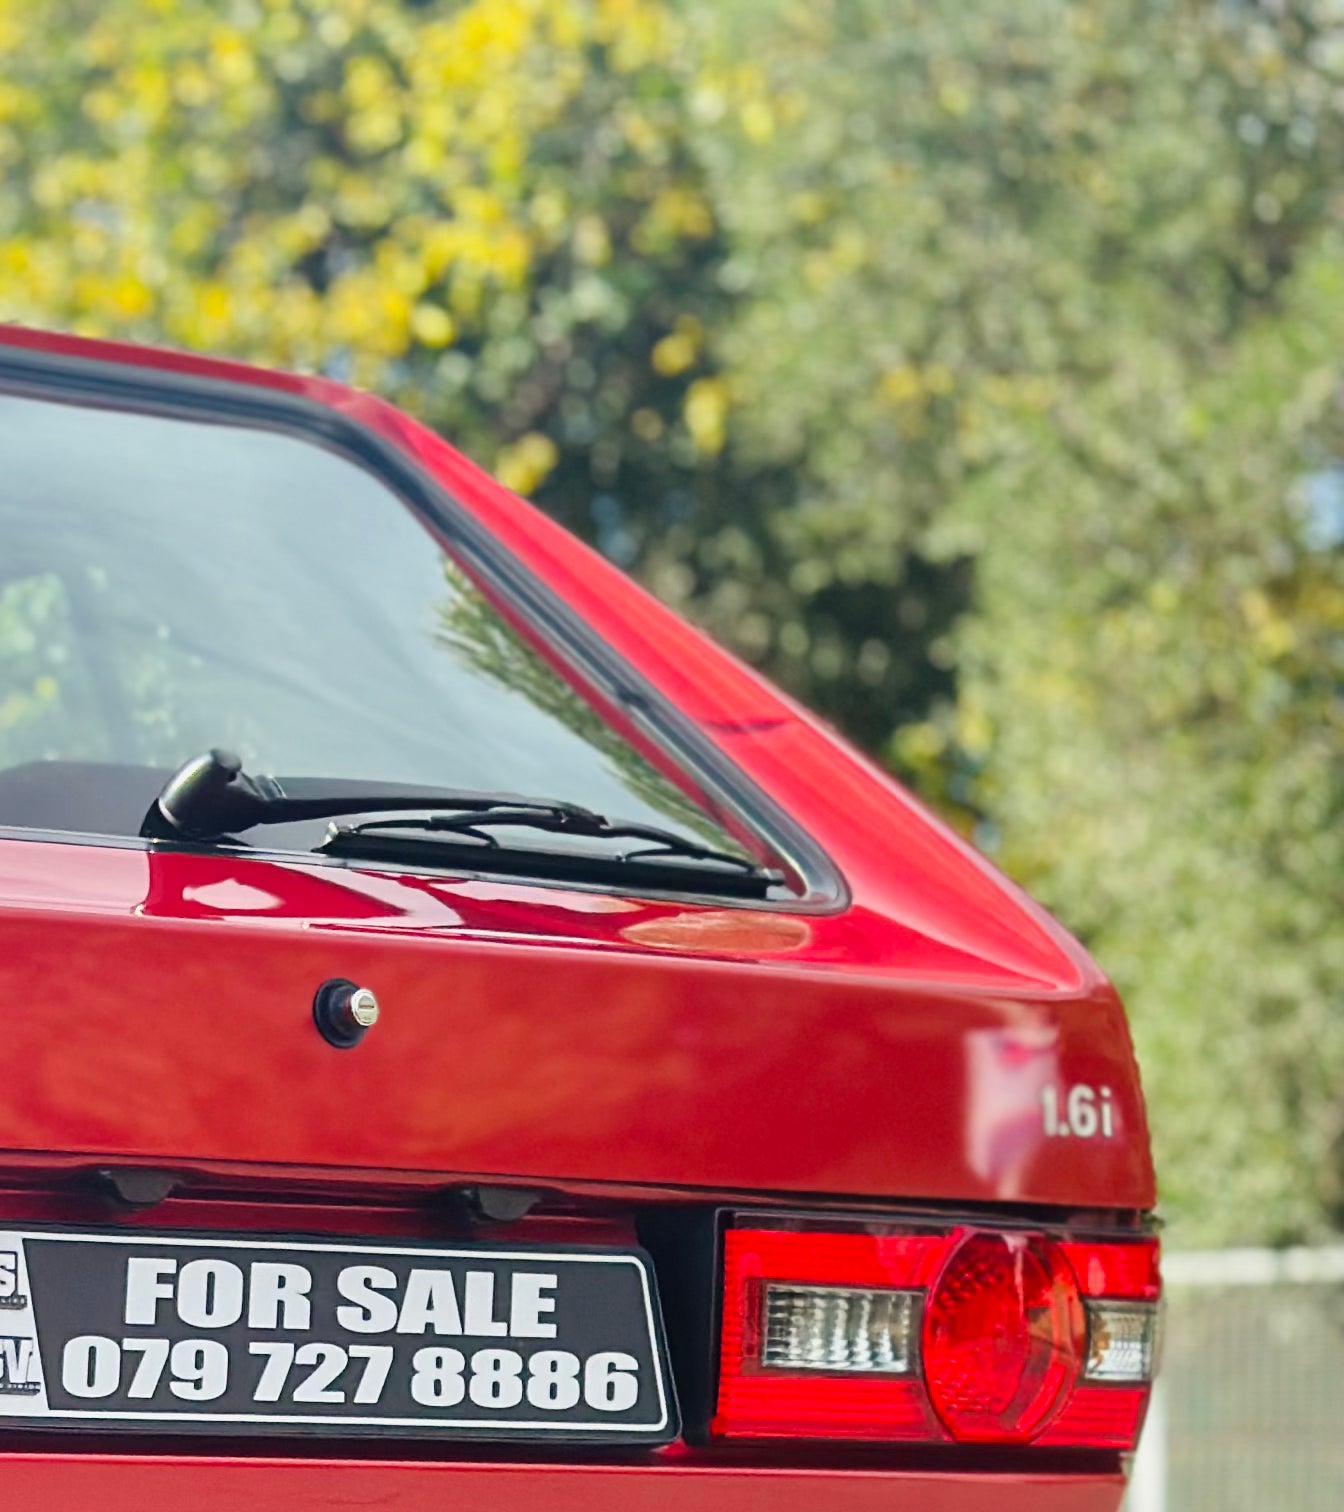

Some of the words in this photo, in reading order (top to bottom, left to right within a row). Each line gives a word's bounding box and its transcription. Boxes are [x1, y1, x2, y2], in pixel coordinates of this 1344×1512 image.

[1041, 1083, 1113, 1138] 1.6i
[124, 1257, 312, 1330] FOR
[336, 1265, 558, 1339] SALE
[61, 1335, 229, 1401] 079
[248, 1341, 394, 1404] 727
[411, 1346, 640, 1412] 8886
